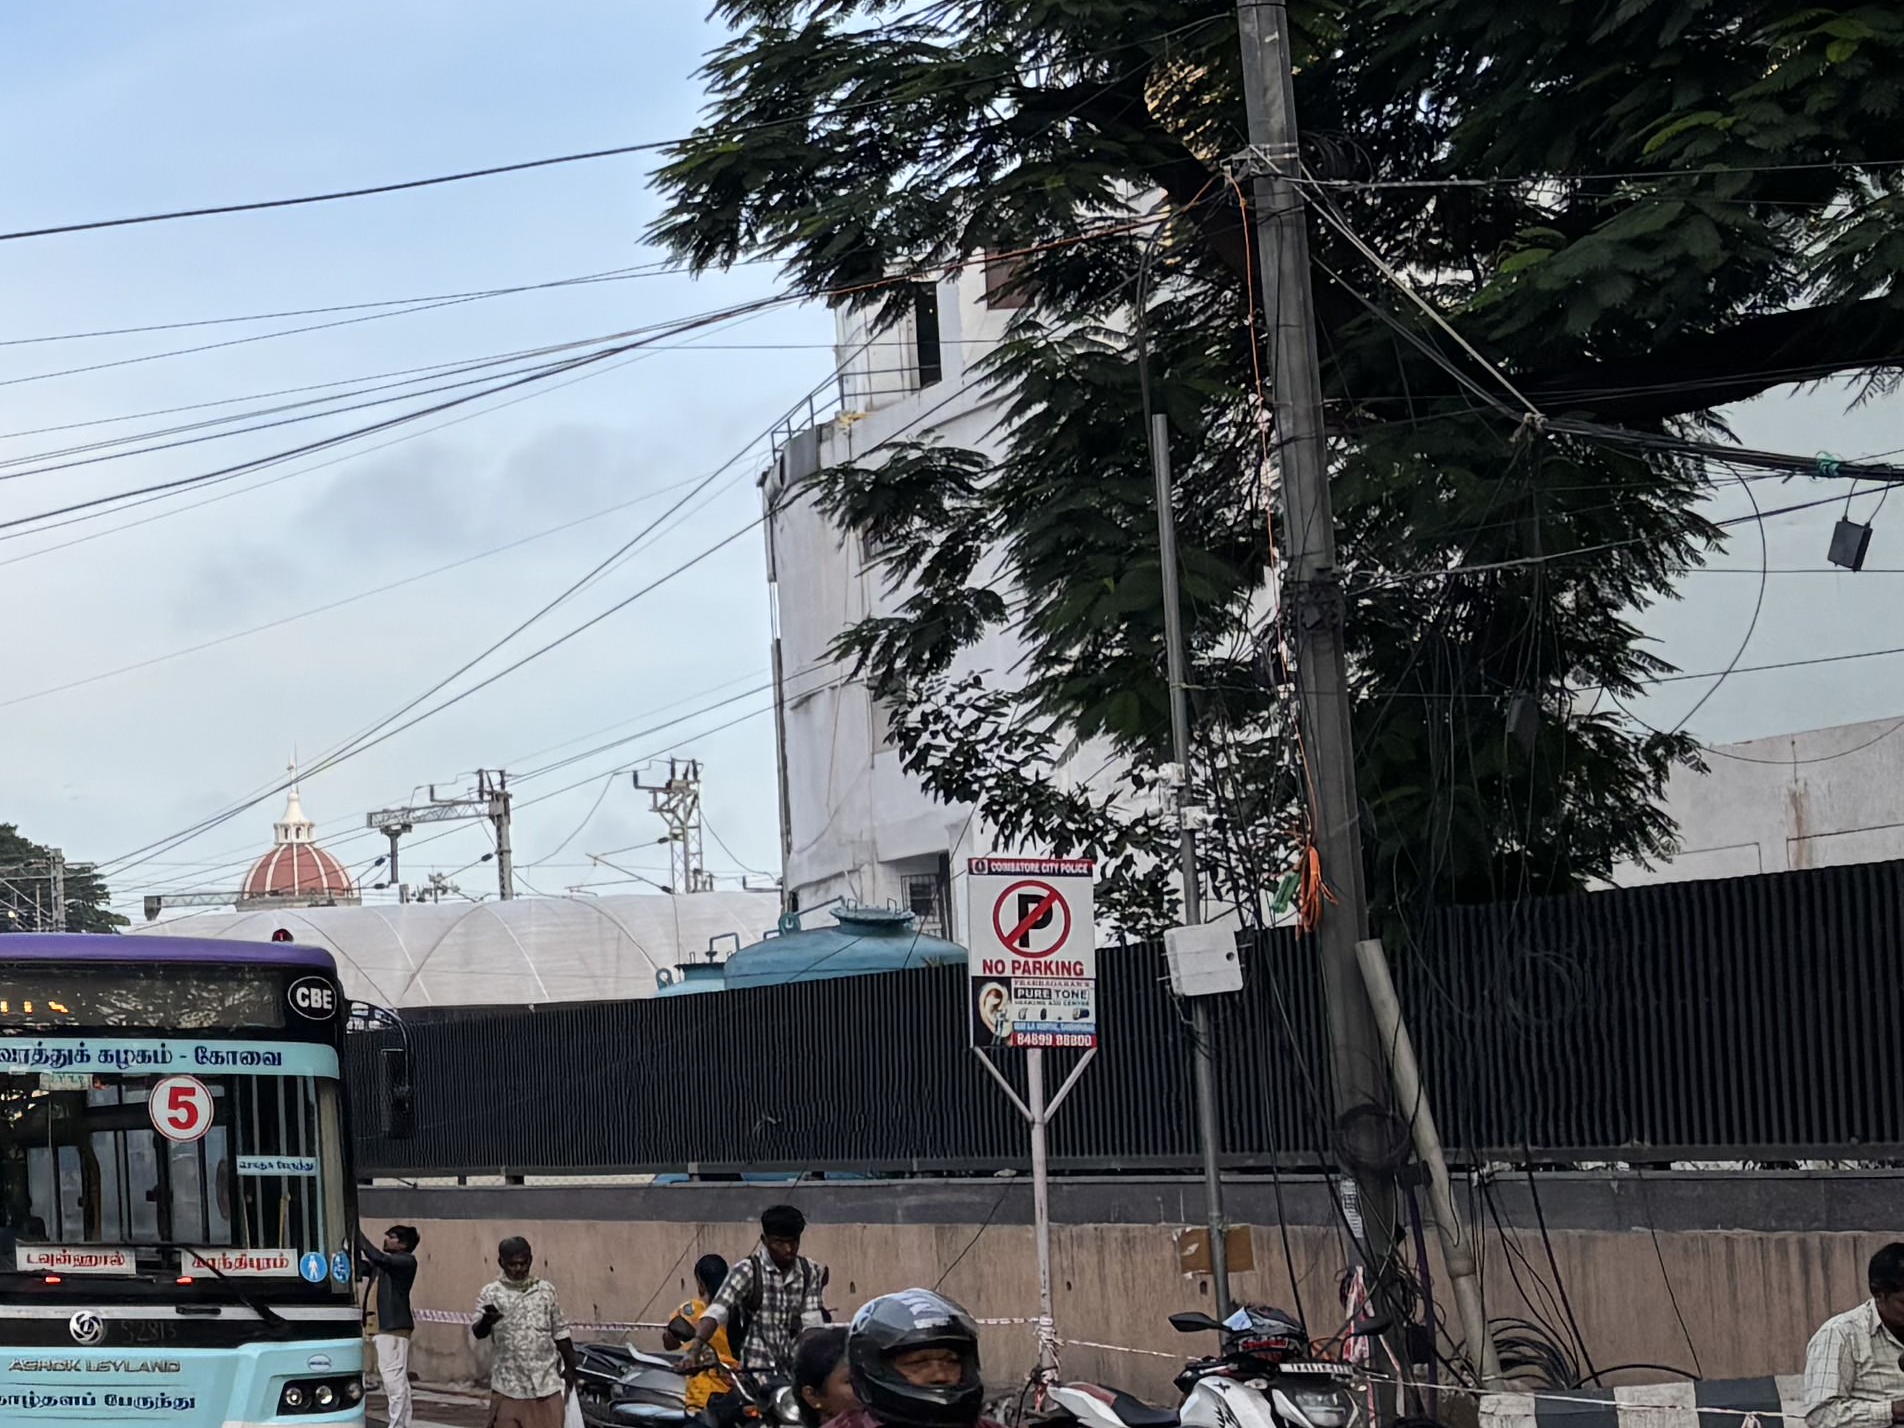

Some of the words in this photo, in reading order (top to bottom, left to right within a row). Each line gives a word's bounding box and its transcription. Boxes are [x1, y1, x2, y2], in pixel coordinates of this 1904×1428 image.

[1042, 863, 1059, 873] CITY
[1061, 863, 1088, 874] POLICE
[983, 959, 1006, 974] NO
[1012, 960, 1084, 976] PARKING
[296, 987, 332, 1009] CBE
[1017, 988, 1050, 998] PURE
[1053, 990, 1088, 999] TONE
[98, 1042, 172, 1069] கழகம்
[194, 1047, 282, 1066] கோவை
[168, 1087, 198, 1130] 5
[193, 1253, 290, 1271] காந்திபுரம்
[8, 1359, 82, 1372] ASHOK
[86, 1359, 181, 1373] LEYLAND
[104, 1393, 196, 1410] பேருந்து
